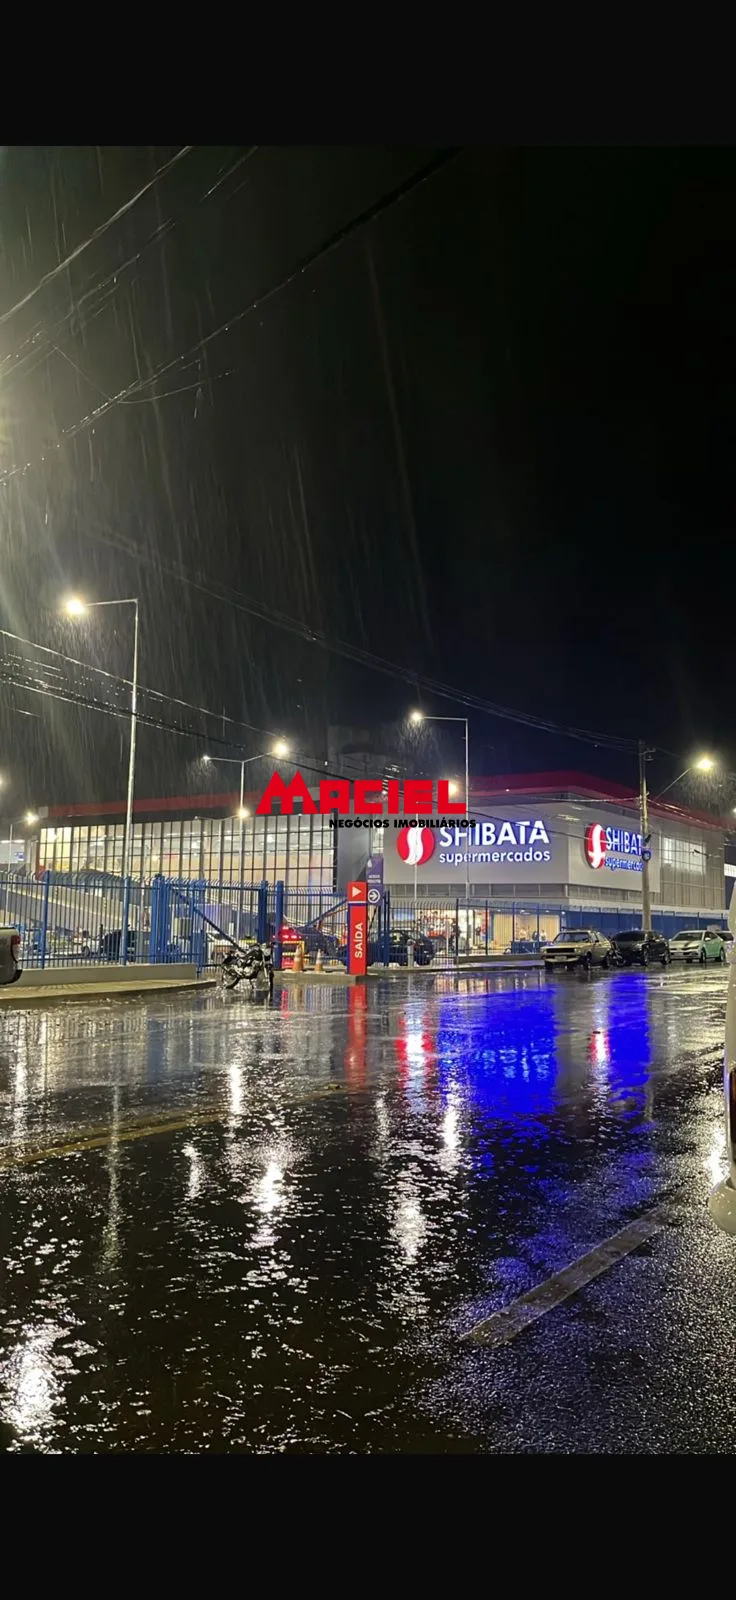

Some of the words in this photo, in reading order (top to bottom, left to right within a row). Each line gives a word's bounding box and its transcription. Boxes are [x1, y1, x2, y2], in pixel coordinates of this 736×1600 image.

[439, 820, 550, 847] SHIBATA
[605, 826, 645, 856] SHIBAT
[439, 847, 551, 867] supermercados
[354, 922, 363, 959] SAÍDA
